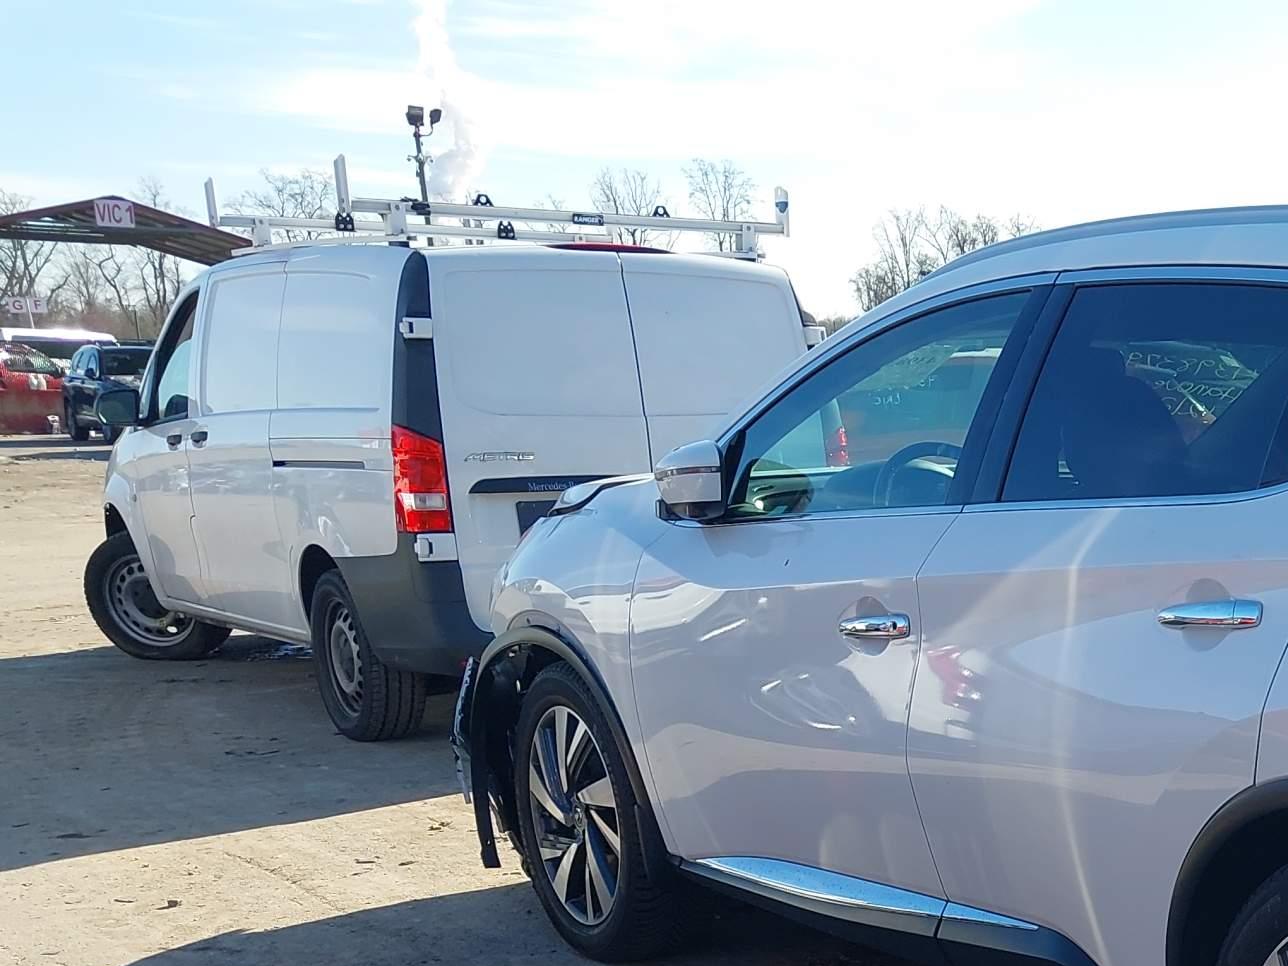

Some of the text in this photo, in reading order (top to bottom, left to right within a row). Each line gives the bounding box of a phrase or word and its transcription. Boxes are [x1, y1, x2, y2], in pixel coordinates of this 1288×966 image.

[95, 202, 134, 225] VIC 1
[12, 299, 24, 311] G
[33, 299, 42, 311] F
[464, 451, 536, 463] METRIS
[527, 481, 577, 493] Mercedes-B
